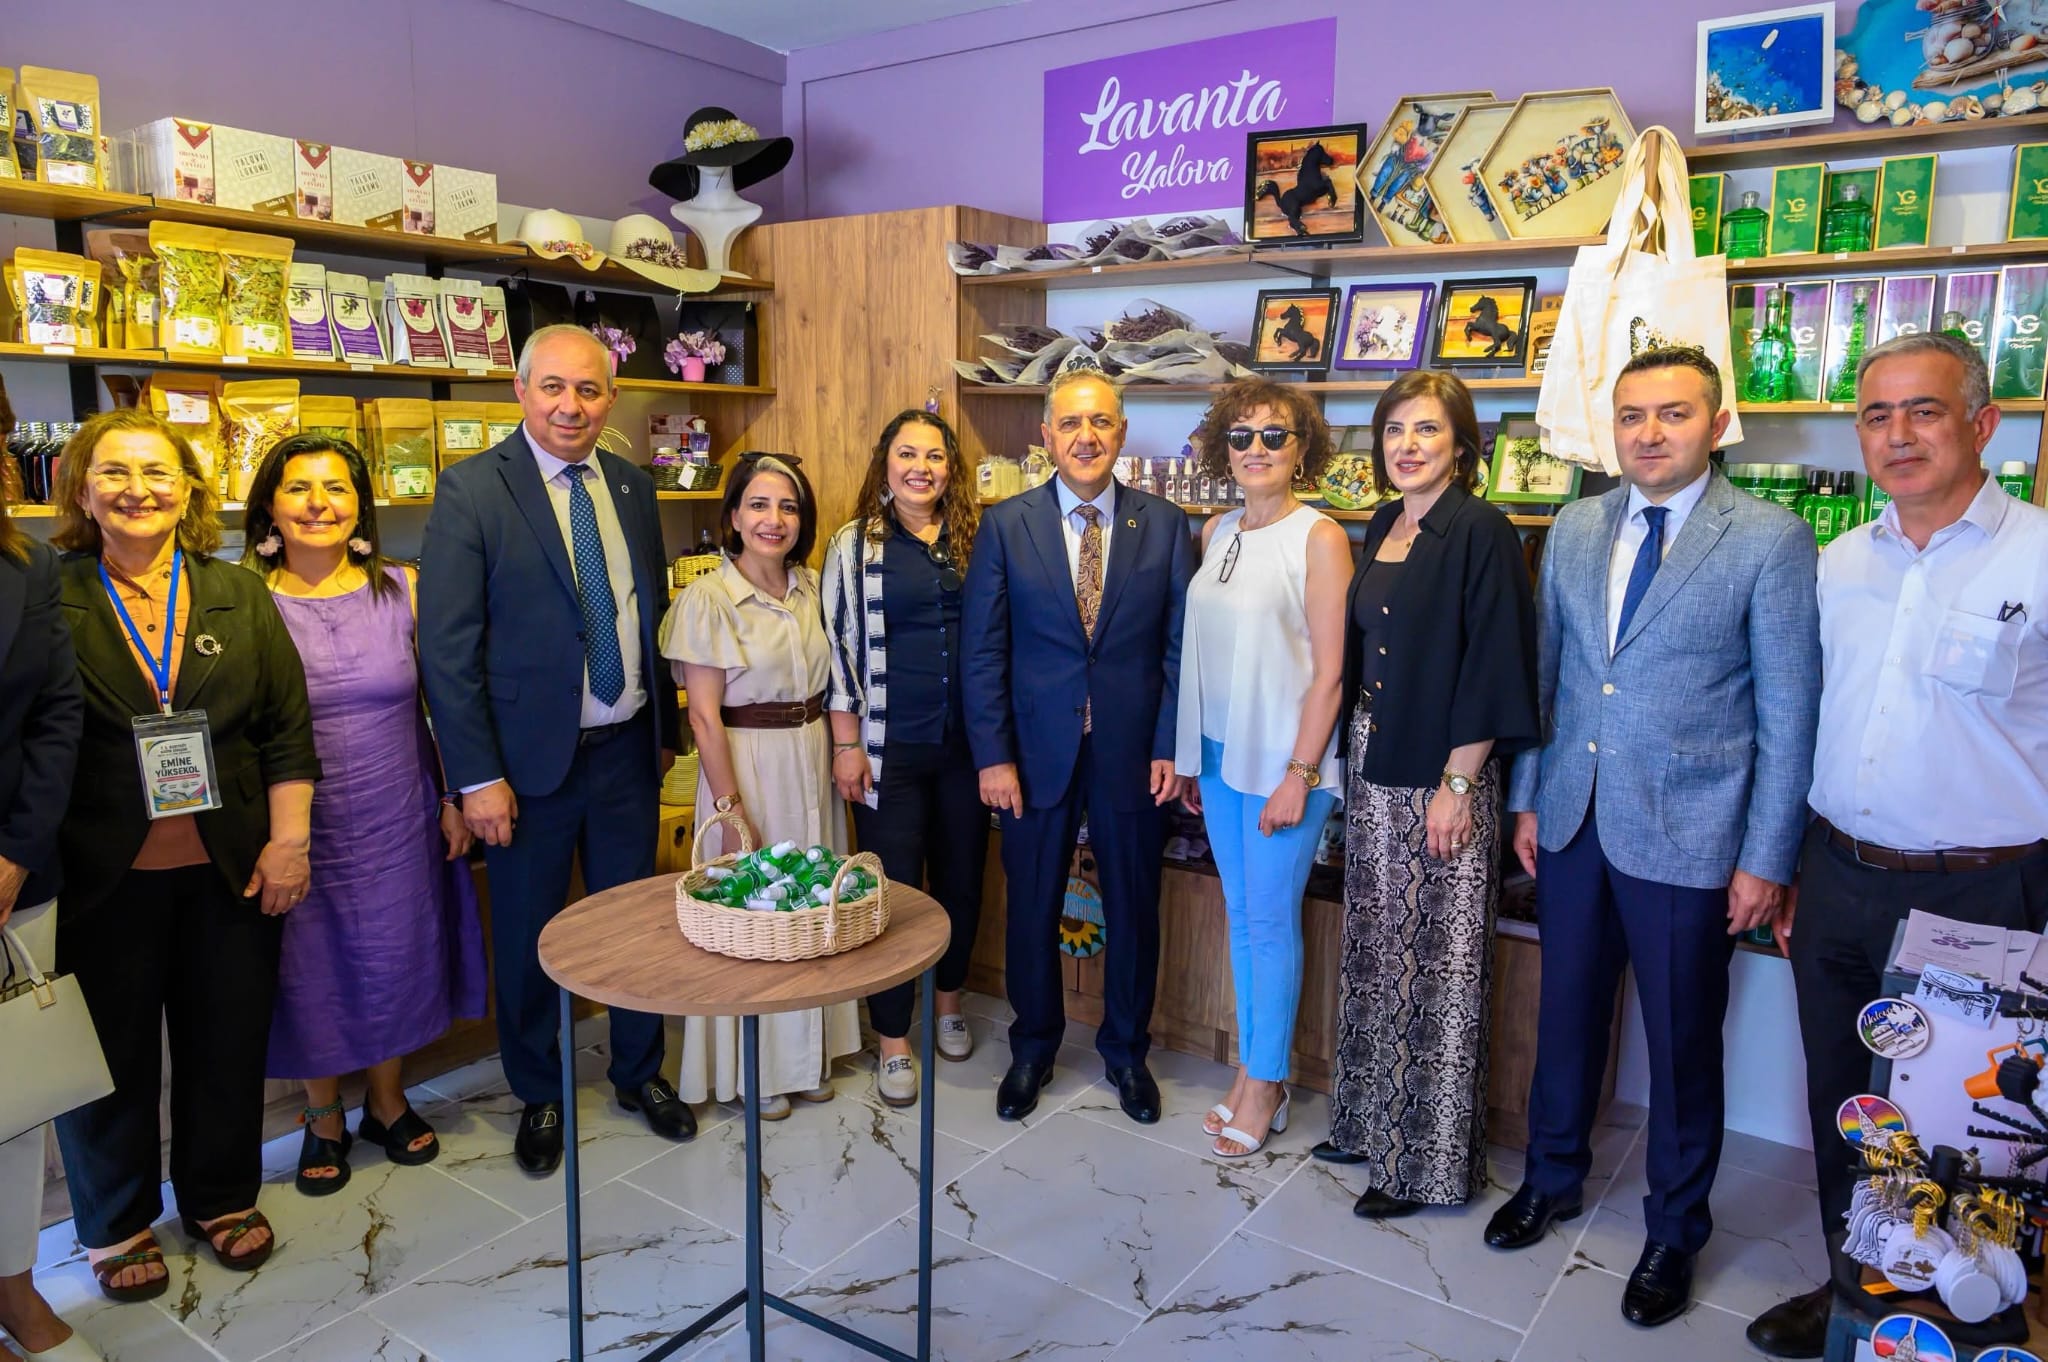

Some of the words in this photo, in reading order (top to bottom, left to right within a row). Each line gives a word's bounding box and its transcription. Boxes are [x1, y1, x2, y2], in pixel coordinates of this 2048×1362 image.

[1078, 69, 1287, 155] Lavanta
[235, 152, 266, 168] YALOVA
[1121, 143, 1234, 199] Yalova
[2011, 314, 2041, 334] YG
[155, 765, 200, 777] YÜKSEKOL
[160, 756, 192, 768] EMİNE
